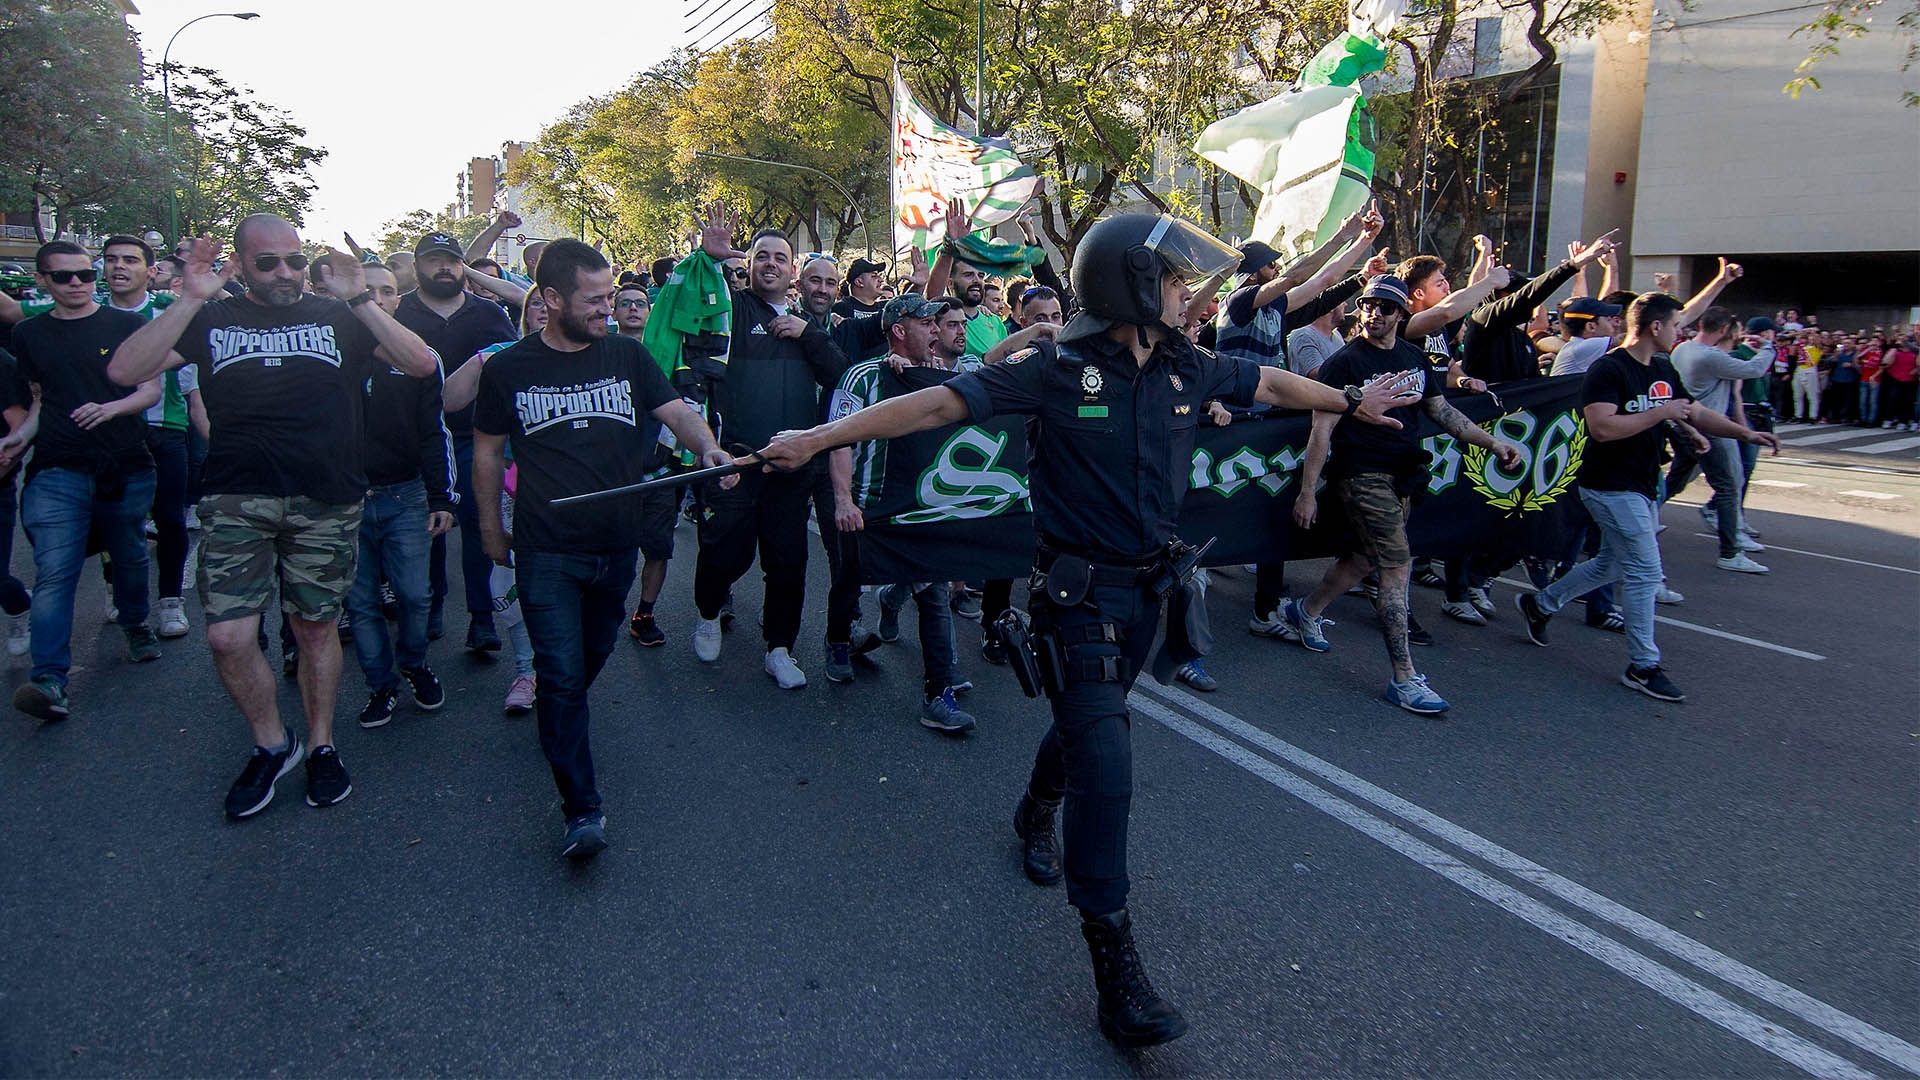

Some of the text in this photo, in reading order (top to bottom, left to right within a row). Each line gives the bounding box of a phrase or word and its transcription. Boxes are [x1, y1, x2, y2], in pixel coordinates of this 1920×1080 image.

[209, 325, 336, 361] SUPPORTERS
[516, 380, 632, 425] SUPPORTERS
[1482, 410, 1577, 496] 86
